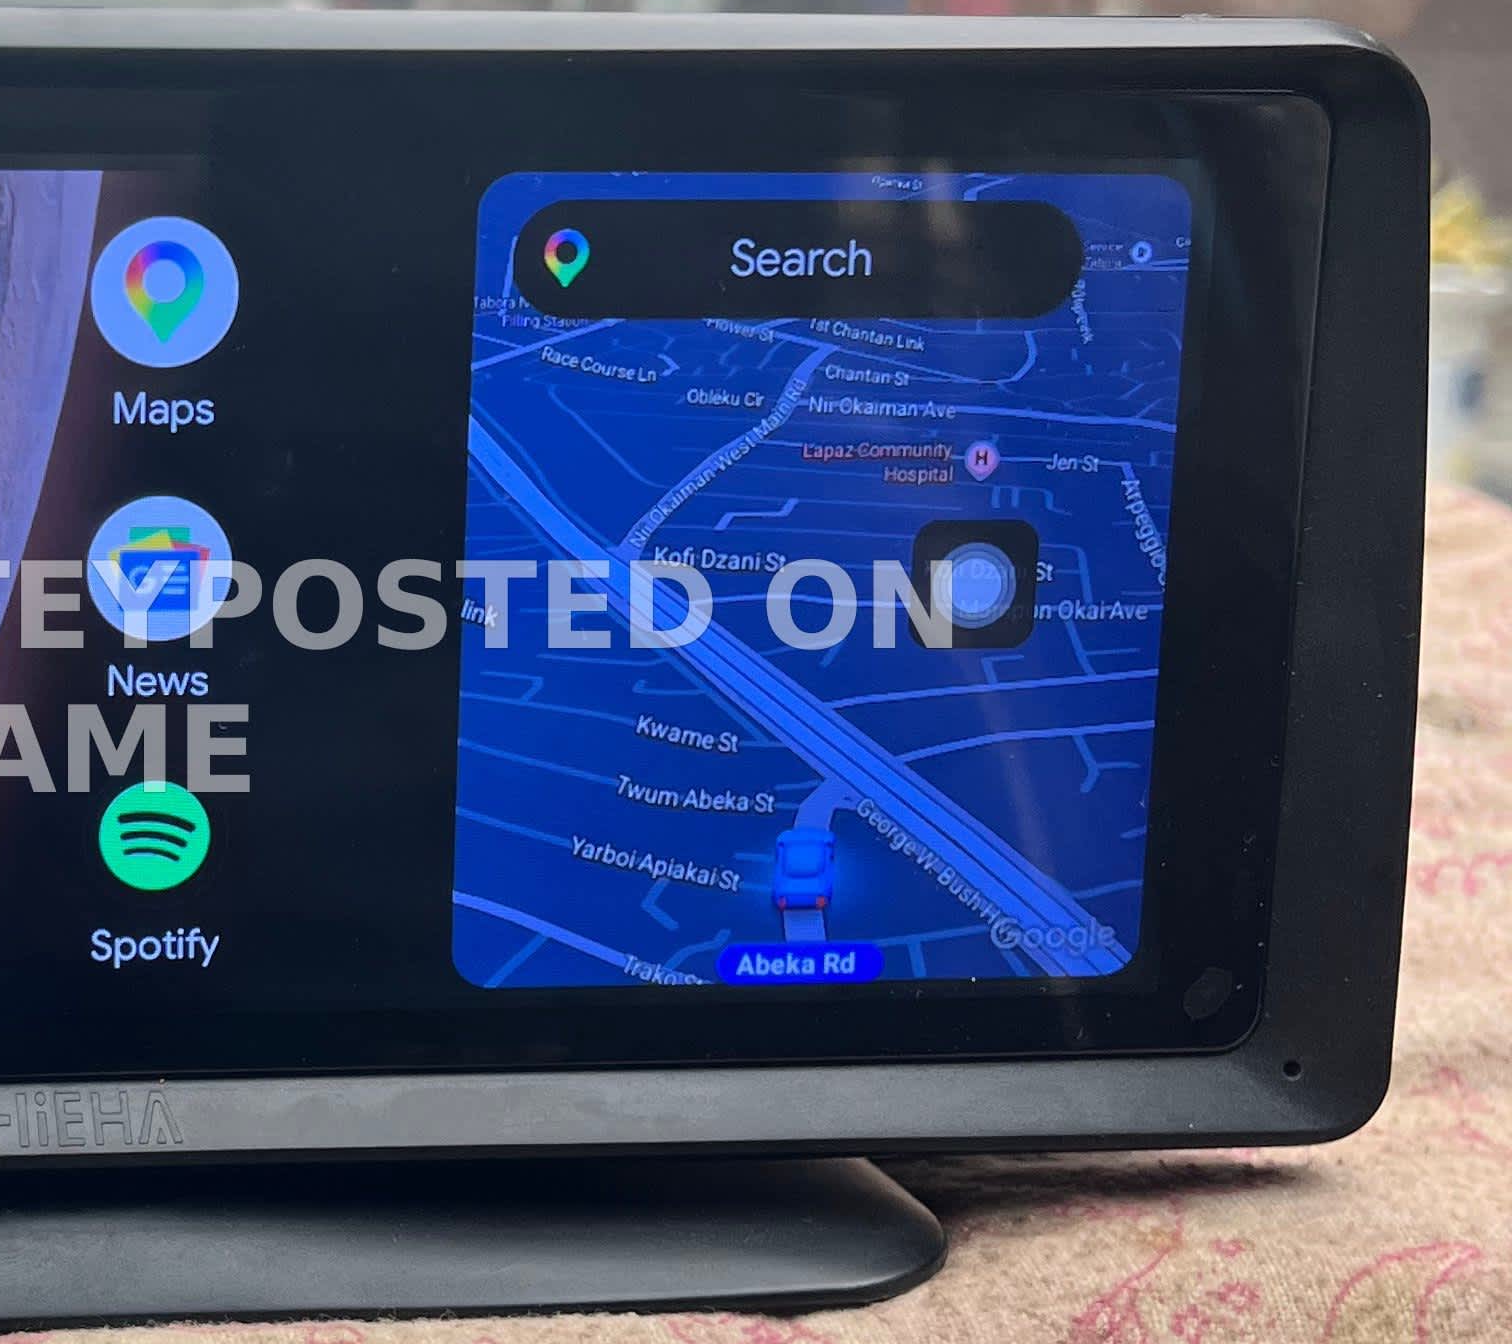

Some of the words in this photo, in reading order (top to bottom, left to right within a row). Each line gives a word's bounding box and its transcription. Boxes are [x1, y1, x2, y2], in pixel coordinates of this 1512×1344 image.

[730, 237, 873, 278] Search
[832, 320, 893, 346] Chantan
[541, 345, 579, 369] Race
[580, 356, 636, 381] Course
[637, 367, 657, 382] Ln
[824, 364, 891, 385] Chantan
[113, 392, 215, 433] Maps
[922, 400, 957, 420] Ave
[857, 442, 954, 462] Community
[1045, 452, 1078, 472] Jen
[1081, 454, 1100, 473] St
[883, 465, 954, 486] Hospital
[653, 546, 696, 568] Kofi
[700, 548, 761, 572] Dzani
[764, 551, 787, 574] St
[1036, 561, 1054, 582] St
[1108, 600, 1149, 622] Ave
[107, 664, 209, 698] News
[636, 714, 715, 751] Kwame
[718, 732, 739, 753] St
[617, 774, 679, 808] Twum
[682, 788, 749, 813] Abeka
[754, 792, 776, 814] St
[571, 835, 638, 870] Yarboi
[638, 853, 718, 887] Apiakai
[718, 869, 741, 893] St
[856, 797, 917, 856] George
[937, 866, 981, 912] Bush
[90, 927, 220, 969] Spotify
[990, 917, 1115, 956] Google
[735, 951, 816, 976] Abeka
[823, 951, 856, 975] Rd
